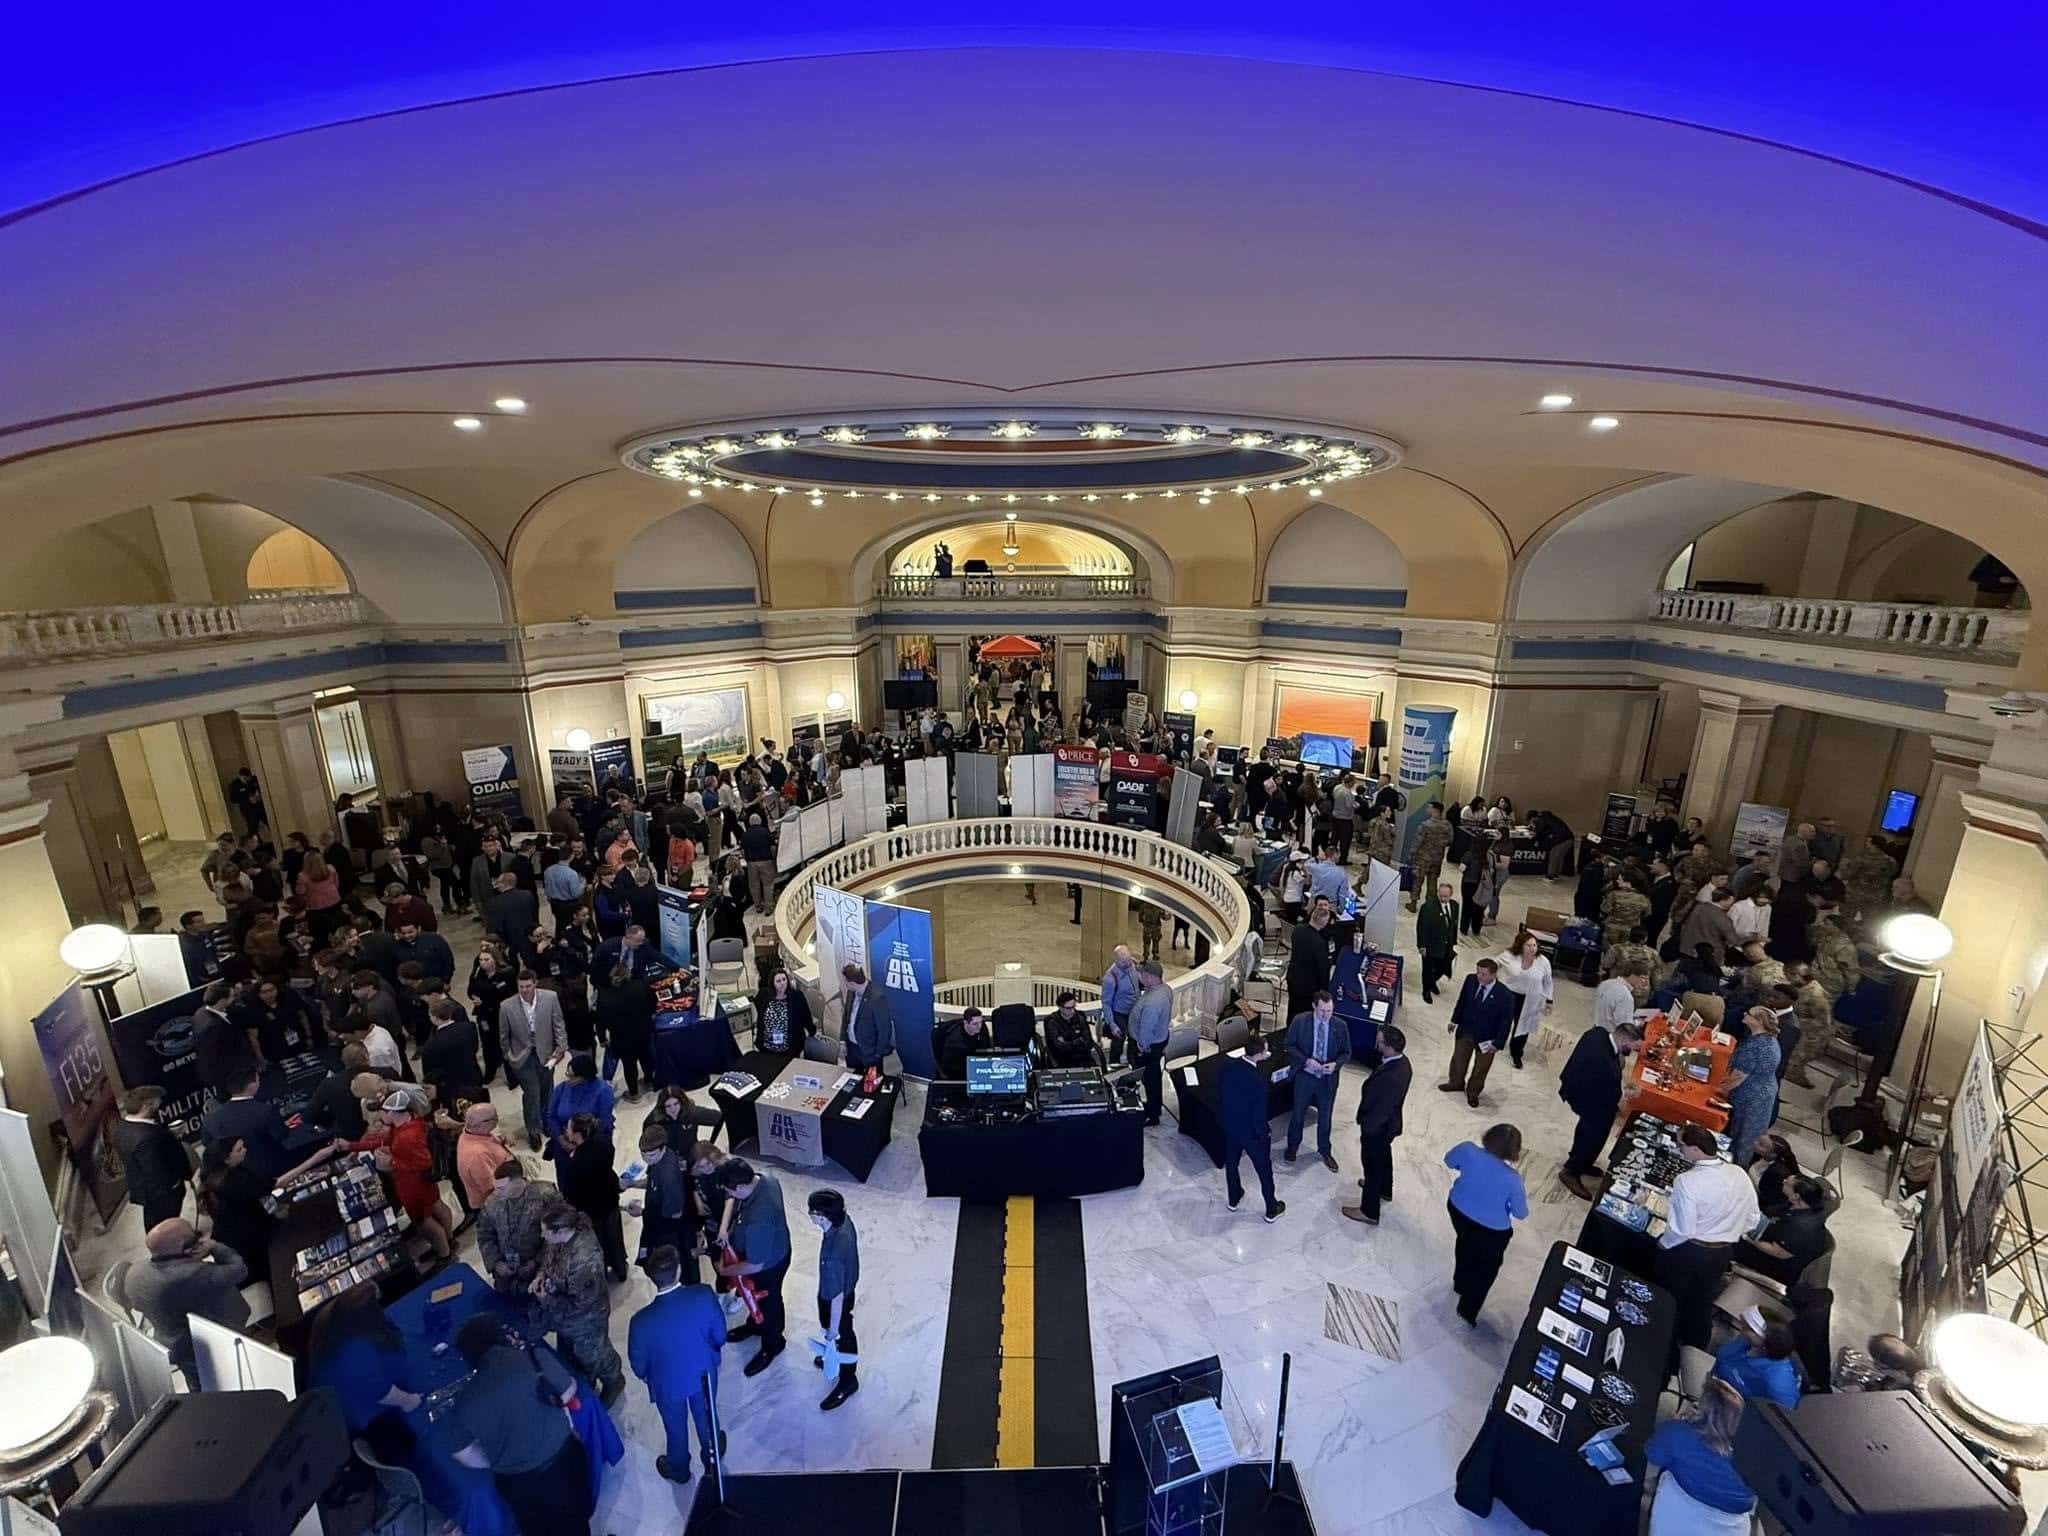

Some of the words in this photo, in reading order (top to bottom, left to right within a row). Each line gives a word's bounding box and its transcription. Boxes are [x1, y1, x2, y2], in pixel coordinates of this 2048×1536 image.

[552, 756, 581, 766] READY
[1068, 750, 1094, 761] PRICE
[472, 781, 510, 795] ODIA
[1513, 849, 1546, 861] RTAN
[844, 896, 862, 965] OKLAH
[176, 1051, 198, 1067] BEYO
[59, 1033, 102, 1104] F135
[158, 1085, 217, 1123] MILITA
